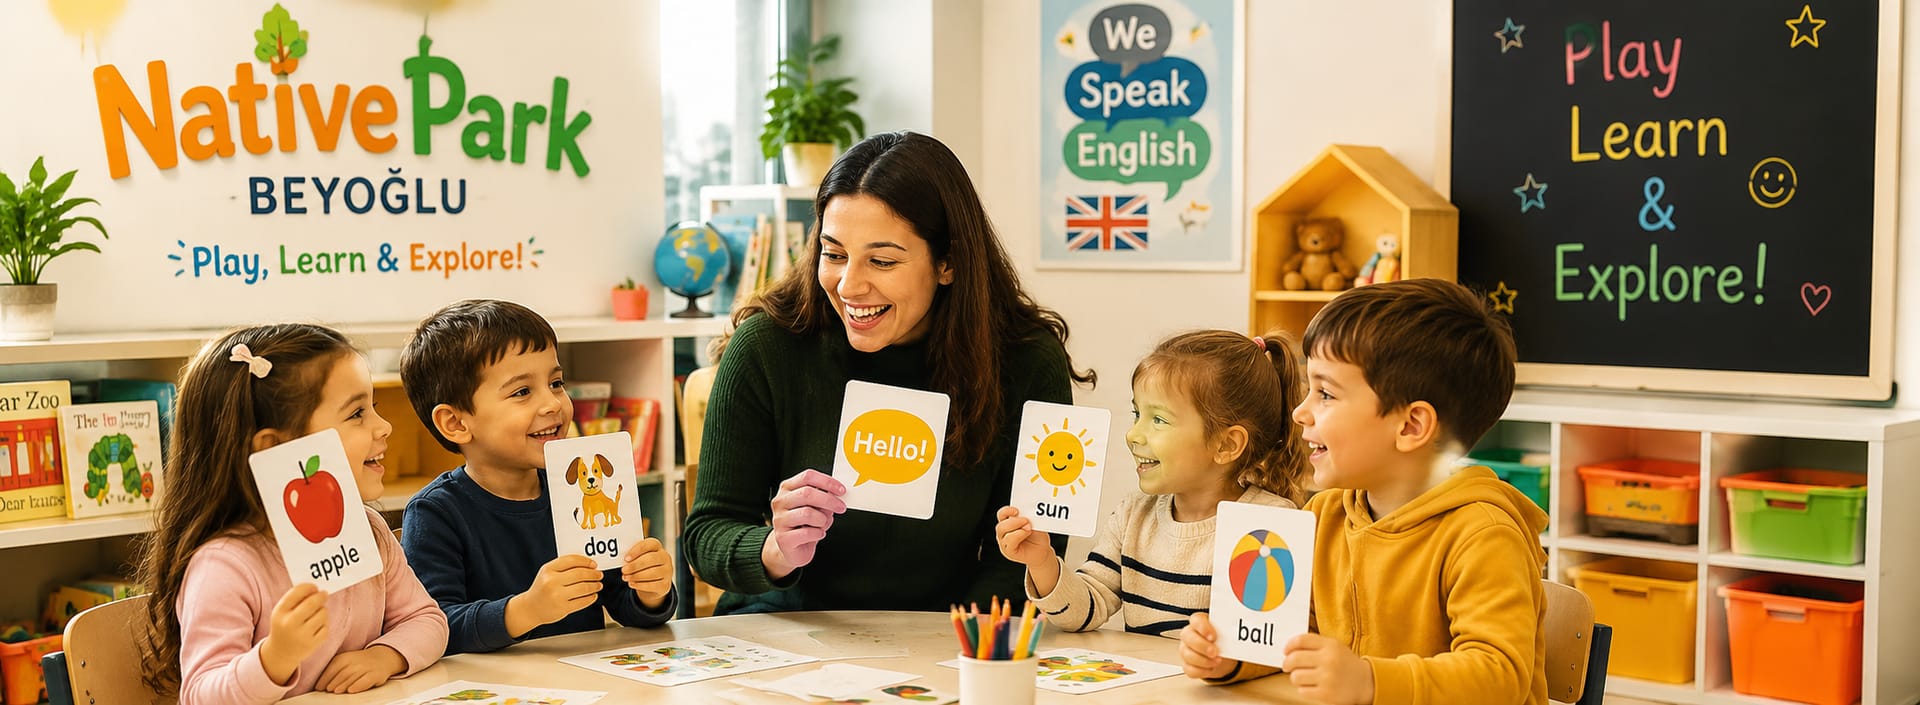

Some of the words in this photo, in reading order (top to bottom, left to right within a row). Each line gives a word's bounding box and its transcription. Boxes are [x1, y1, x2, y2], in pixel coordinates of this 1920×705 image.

[1103, 16, 1157, 51] We
[1565, 20, 1682, 98] Play
[93, 60, 399, 180] Native
[402, 37, 592, 178] Park
[1079, 69, 1191, 118] Speak
[1077, 130, 1196, 176] English
[1571, 105, 1728, 163] Learn
[248, 168, 467, 215] BEYOĞLU
[1638, 177, 1677, 231] &
[192, 245, 269, 285] Play,
[279, 245, 366, 274] Learn
[376, 243, 399, 272] &
[410, 242, 523, 279] Explore!
[1555, 243, 1767, 321] Explore!
[25, 391, 60, 410] Zoo
[73, 413, 98, 429] The
[852, 432, 927, 463] Hello!
[1035, 500, 1070, 521] sun
[310, 544, 361, 581] apple
[584, 536, 619, 558] dog
[1237, 617, 1274, 647] ball
